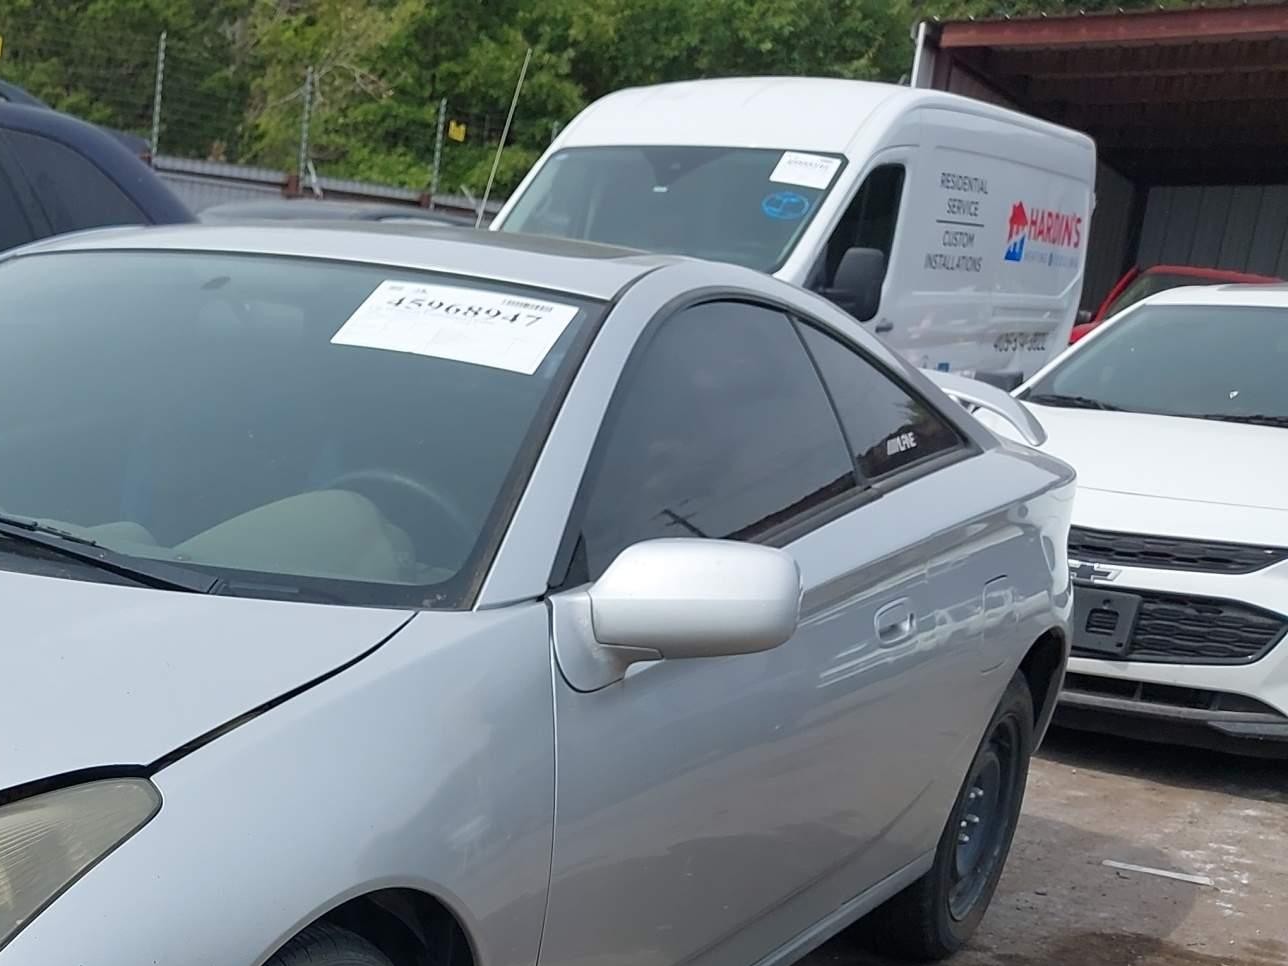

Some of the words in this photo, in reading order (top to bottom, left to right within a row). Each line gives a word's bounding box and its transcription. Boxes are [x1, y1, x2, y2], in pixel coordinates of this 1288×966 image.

[939, 171, 989, 195] RESIDENTIAL
[946, 197, 980, 217] SERVICE
[942, 229, 976, 249] CUSTOM
[1027, 207, 1083, 249] HARDIN'S
[923, 252, 983, 273] INSTALLATIONS
[386, 296, 544, 328] 45968947
